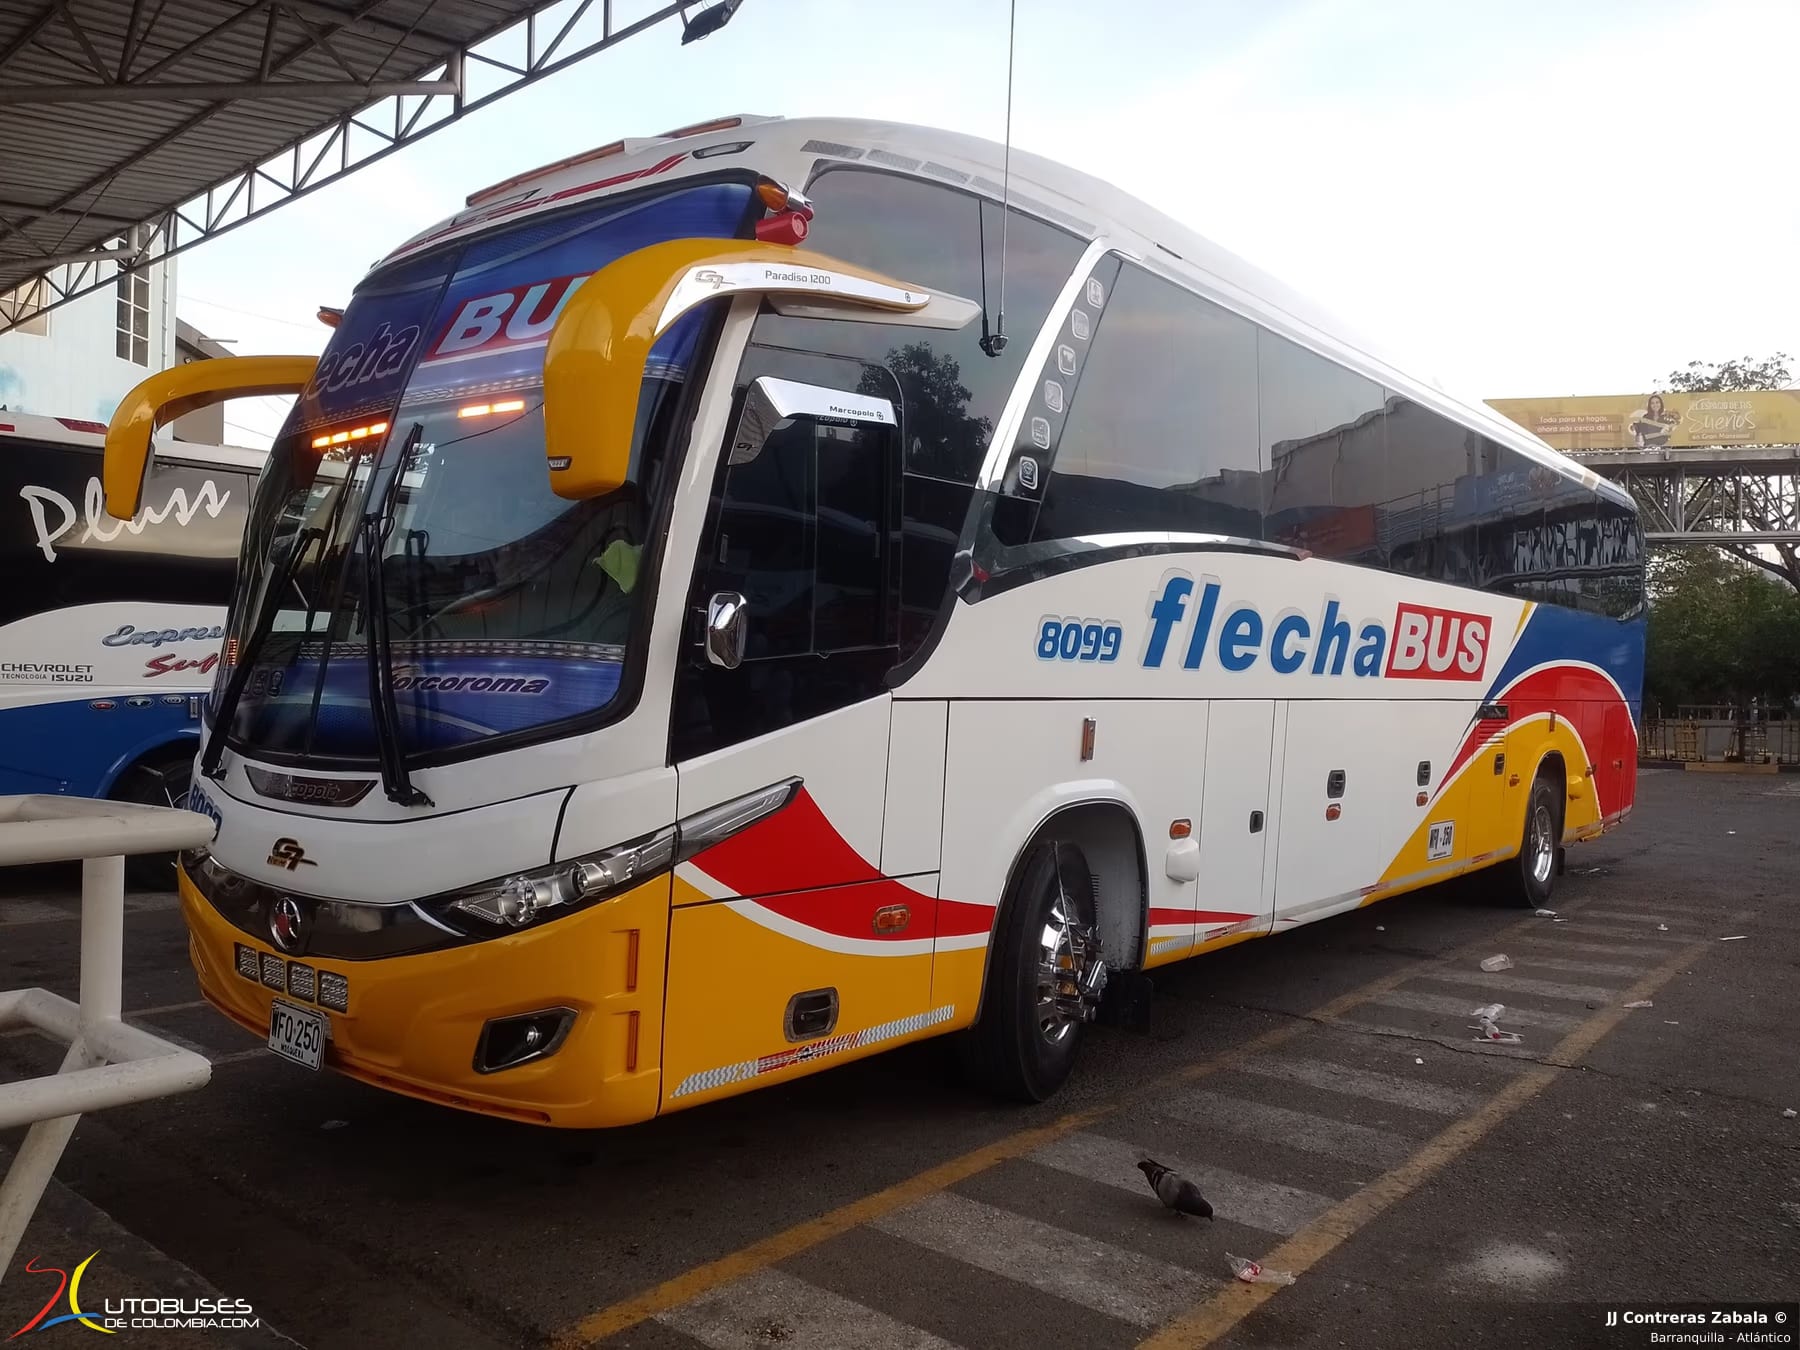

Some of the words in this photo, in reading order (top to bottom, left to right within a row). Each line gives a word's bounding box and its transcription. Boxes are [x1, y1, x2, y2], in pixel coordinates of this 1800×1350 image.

[765, 270, 808, 283] Paradiso
[810, 274, 831, 285] 1200
[434, 275, 594, 355] BU
[829, 405, 875, 417] Marcopolo
[1559, 416, 1576, 424] para
[1036, 617, 1122, 662] 8099
[1141, 570, 1387, 677] flecha
[1391, 612, 1487, 674] BUS
[1, 663, 94, 673] CHEVROLET
[51, 674, 94, 682] ISUZU
[392, 673, 550, 694] orcoroma
